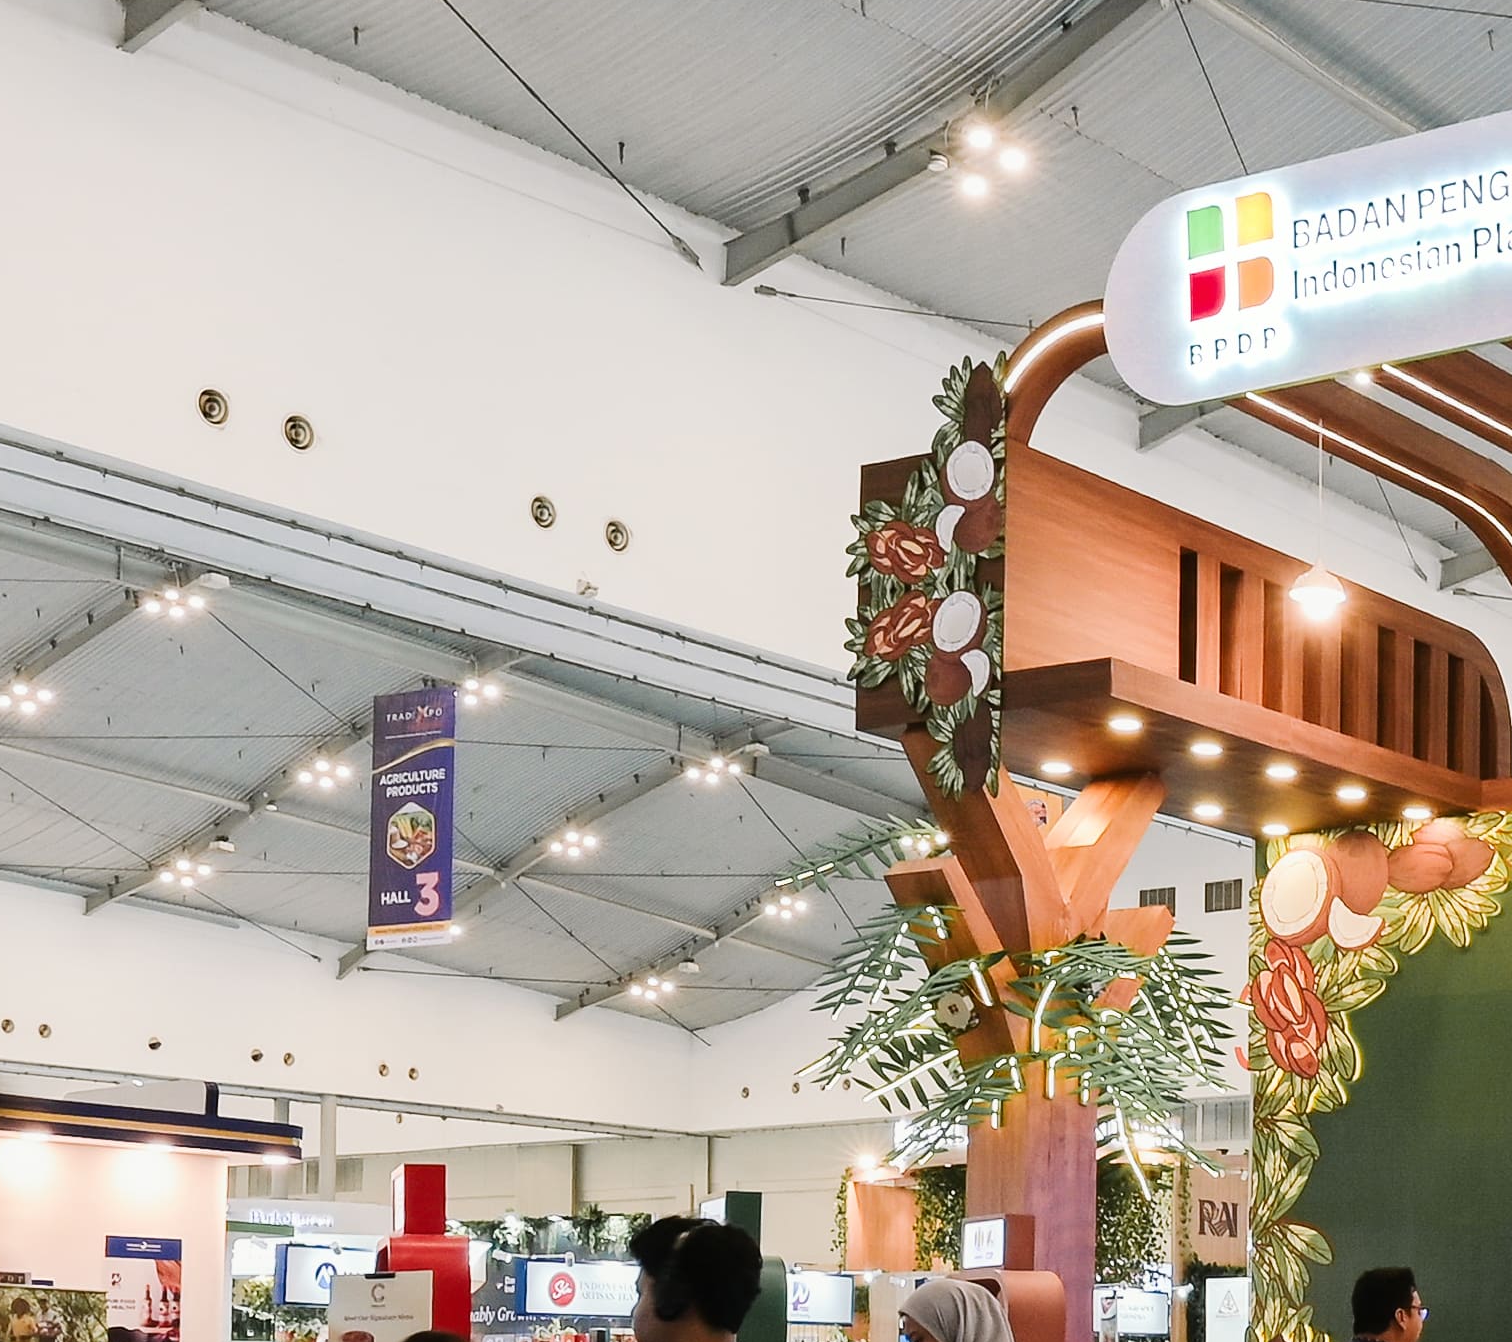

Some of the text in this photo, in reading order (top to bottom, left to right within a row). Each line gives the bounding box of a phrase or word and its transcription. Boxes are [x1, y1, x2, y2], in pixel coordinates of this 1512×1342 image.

[1292, 193, 1407, 250] BADAN
[1292, 239, 1462, 300] Indonesian
[379, 768, 447, 787] AGRICULTURE
[385, 782, 438, 799] PRODUCTS
[380, 871, 441, 918] HALL 3
